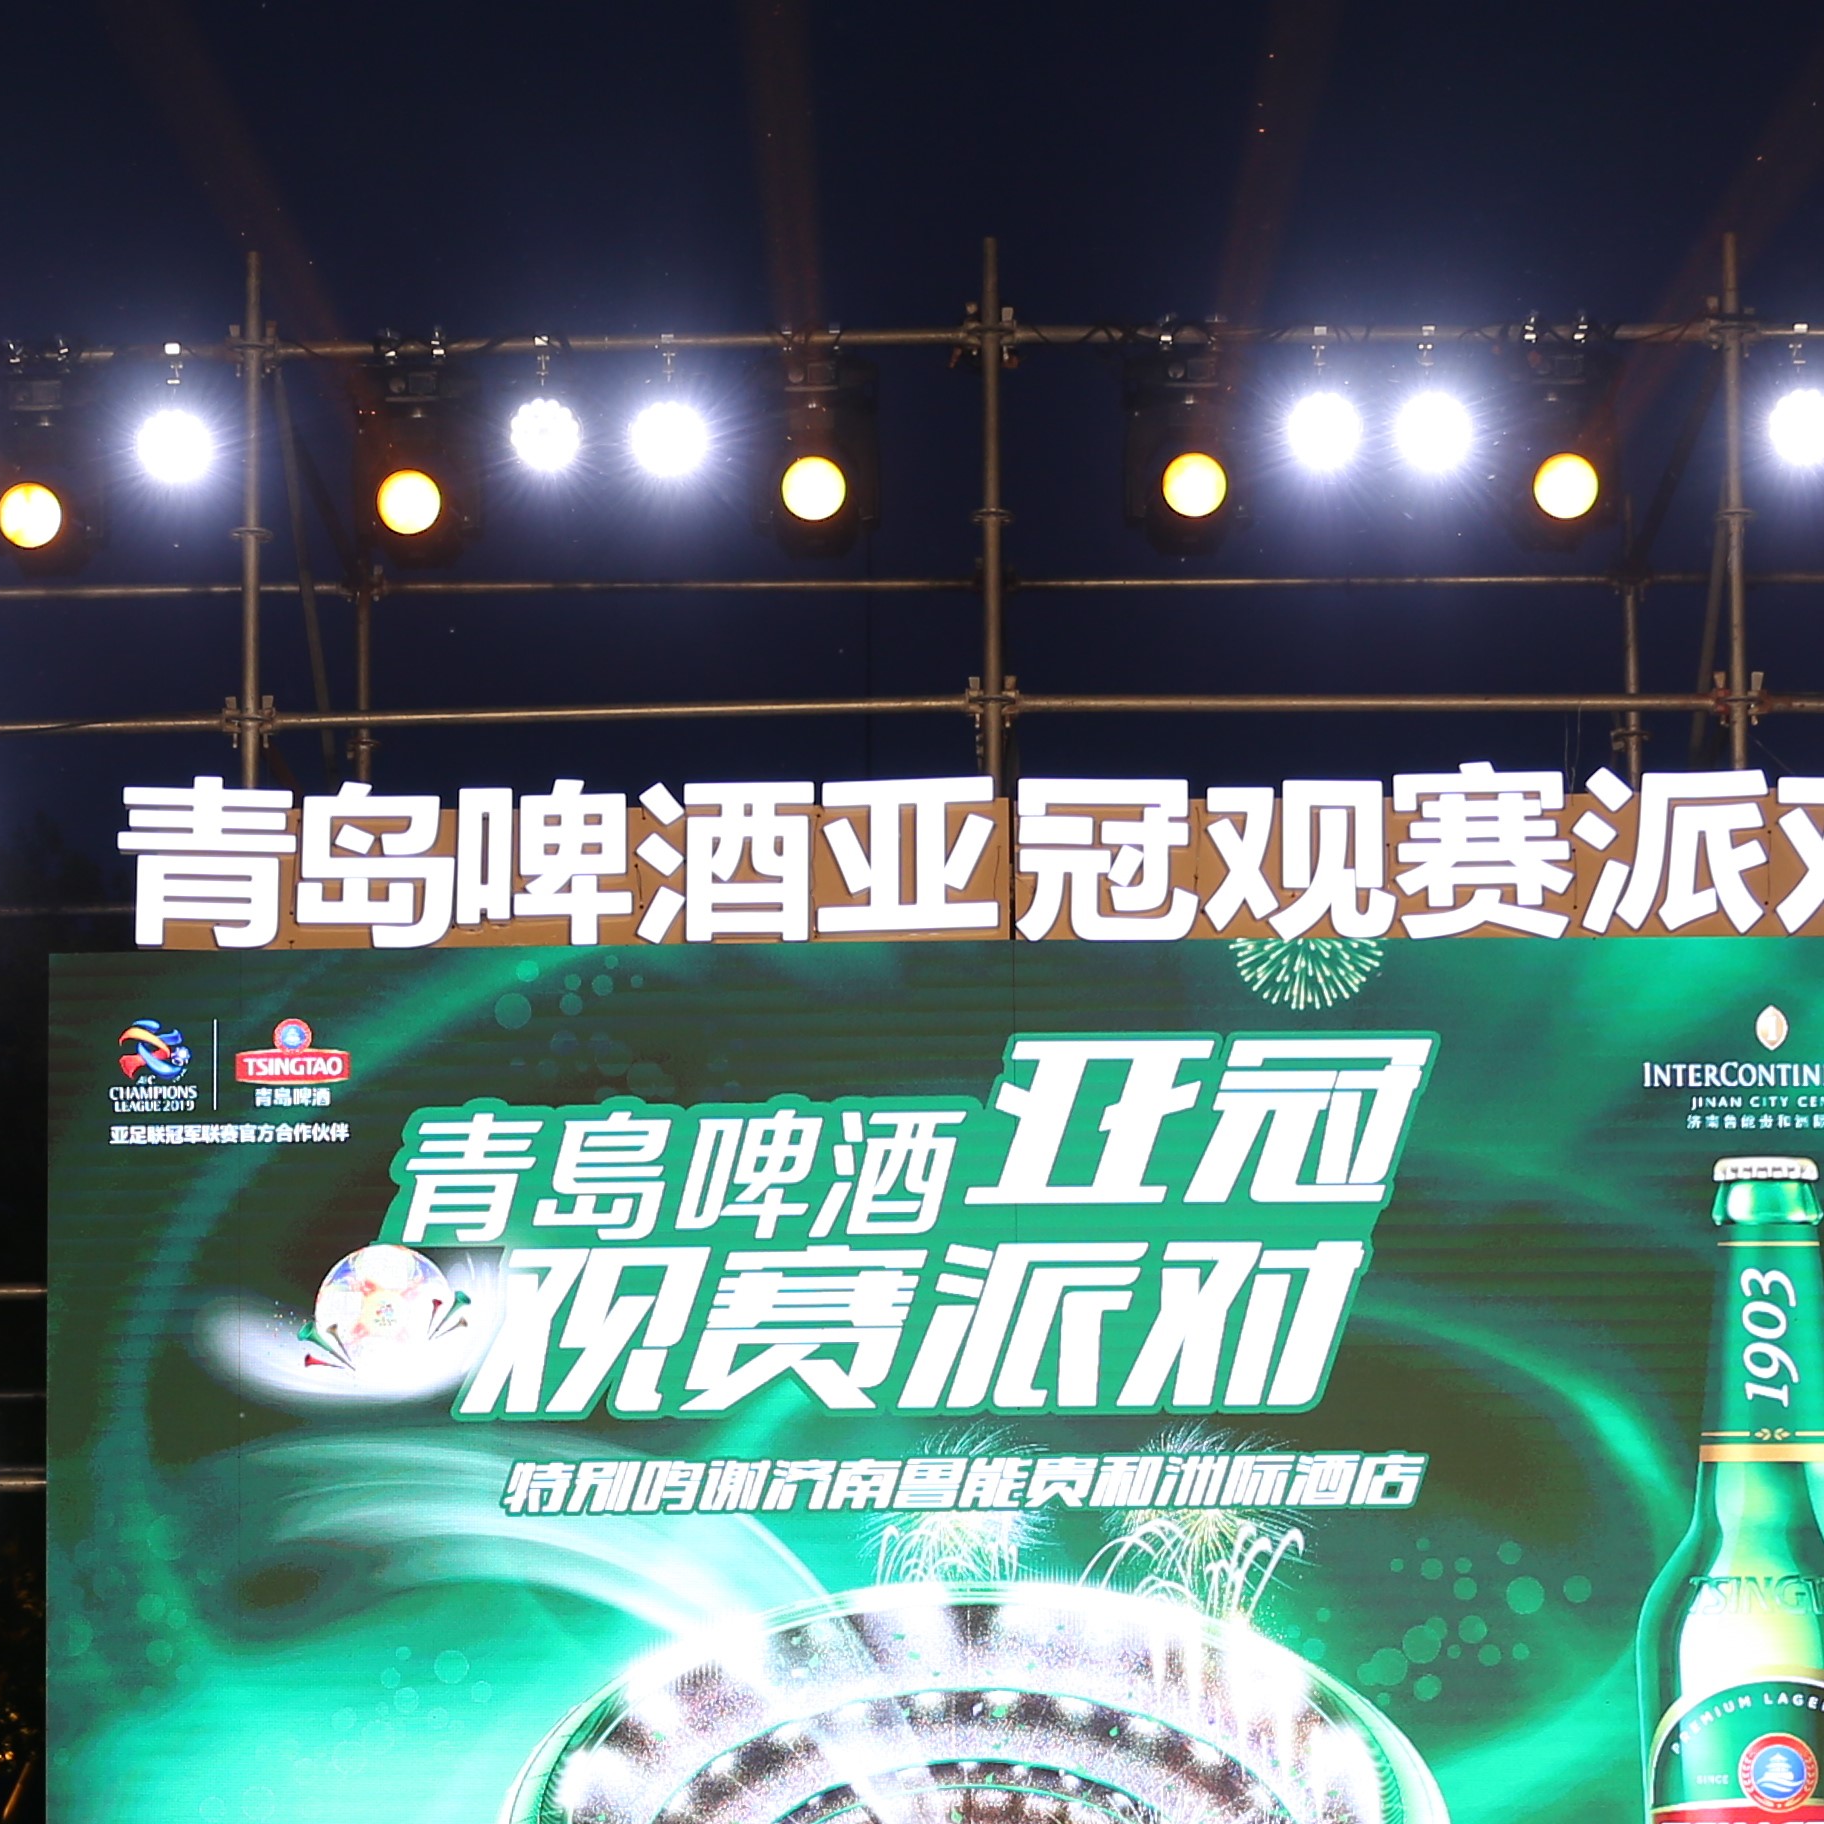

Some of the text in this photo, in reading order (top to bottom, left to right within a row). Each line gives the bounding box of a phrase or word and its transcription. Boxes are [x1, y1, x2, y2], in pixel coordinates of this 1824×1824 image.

[243, 1057, 343, 1076] TSINGTAO
[109, 1086, 198, 1100] CHAMPIONS
[114, 1099, 195, 1112] LEAGUE 2019
[1691, 1096, 1742, 1110] JINAN
[1749, 1096, 1789, 1108] CITY
[1740, 1267, 1800, 1408] 1903
[1671, 1694, 1753, 1754] PREMIUM
